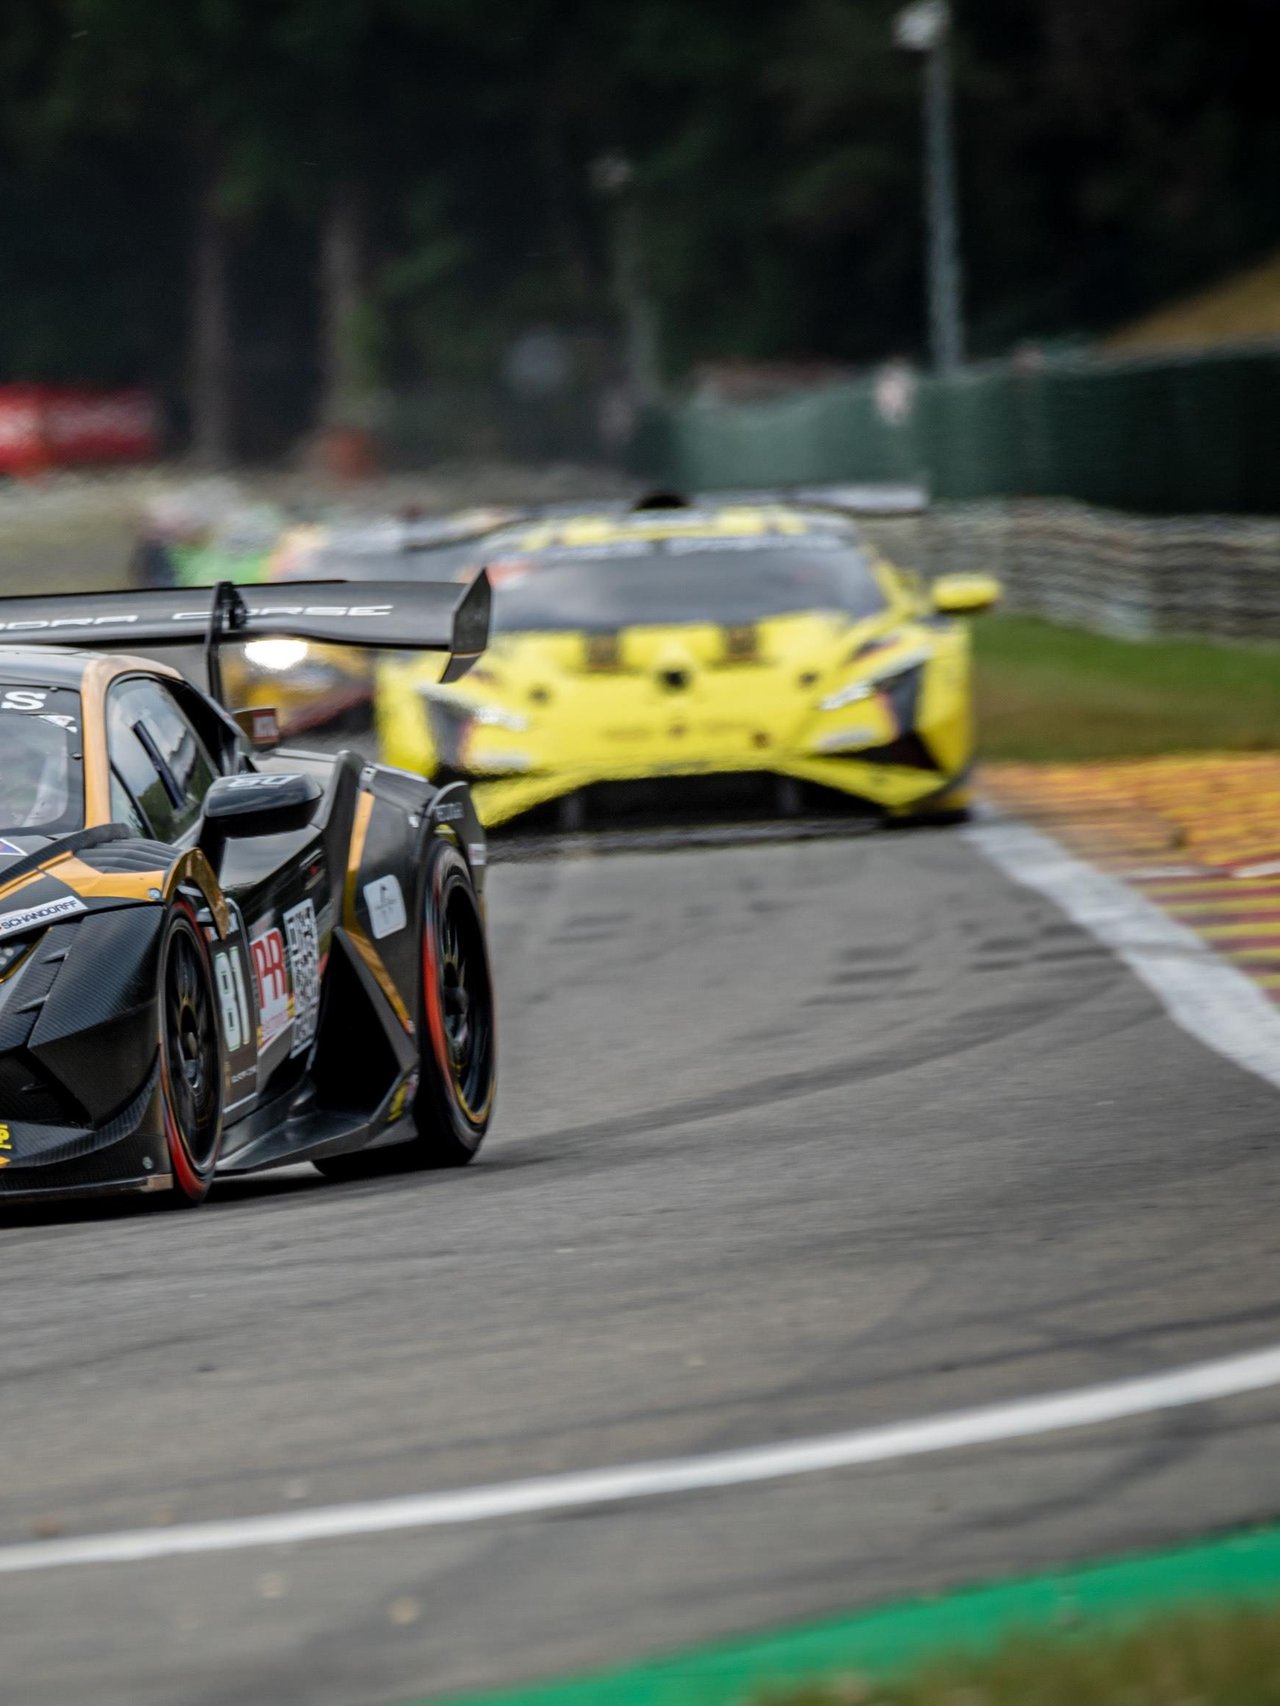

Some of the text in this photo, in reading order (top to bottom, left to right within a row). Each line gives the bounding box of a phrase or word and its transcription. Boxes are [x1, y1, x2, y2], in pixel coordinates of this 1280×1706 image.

[172, 604, 395, 620] CRSE
[1, 900, 78, 930] SCHANDORFF
[251, 929, 288, 1009] PR
[214, 945, 251, 1052] 81
